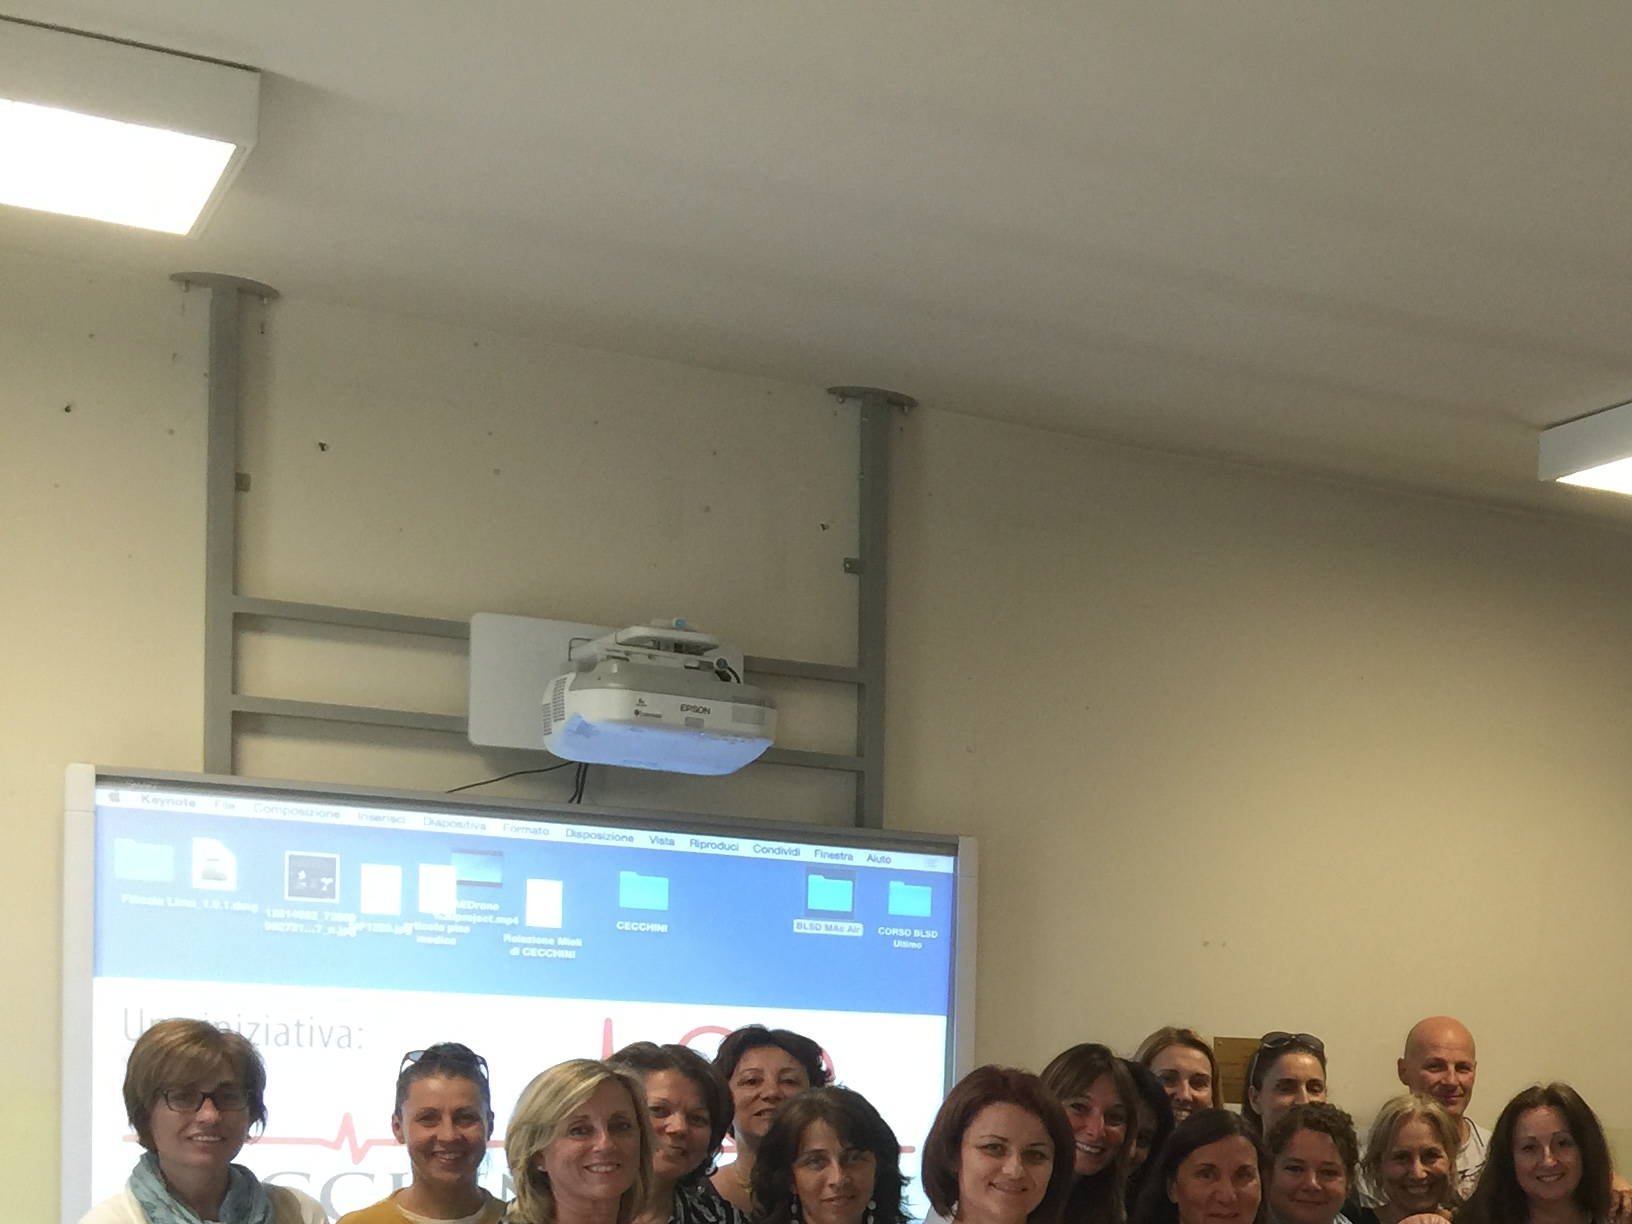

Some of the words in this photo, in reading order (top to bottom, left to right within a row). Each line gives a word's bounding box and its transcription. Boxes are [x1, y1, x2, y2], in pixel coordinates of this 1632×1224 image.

[680, 703, 711, 715] EPSON
[141, 793, 196, 808] Keynote
[215, 799, 236, 811] File
[253, 802, 341, 819] Composizione
[357, 811, 406, 824] Inserisci
[422, 816, 487, 832] Diapositiva
[502, 823, 550, 836] Formato
[565, 828, 635, 844] Disposizione
[649, 835, 676, 847] Vista
[689, 838, 740, 852] Riproduci
[752, 843, 801, 857] Condividi
[814, 848, 854, 862] Finestra
[866, 853, 892, 865] Aiuto
[616, 920, 668, 933] CECCHINI
[795, 921, 822, 932] BLSD
[878, 926, 912, 937] CORSO
[913, 929, 939, 939] BLSD
[503, 933, 555, 946] Relazione
[893, 938, 923, 950] Ultimo
[509, 946, 520, 956] di
[522, 947, 576, 959] CECCHINI
[204, 1010, 363, 1049] iziativa:
